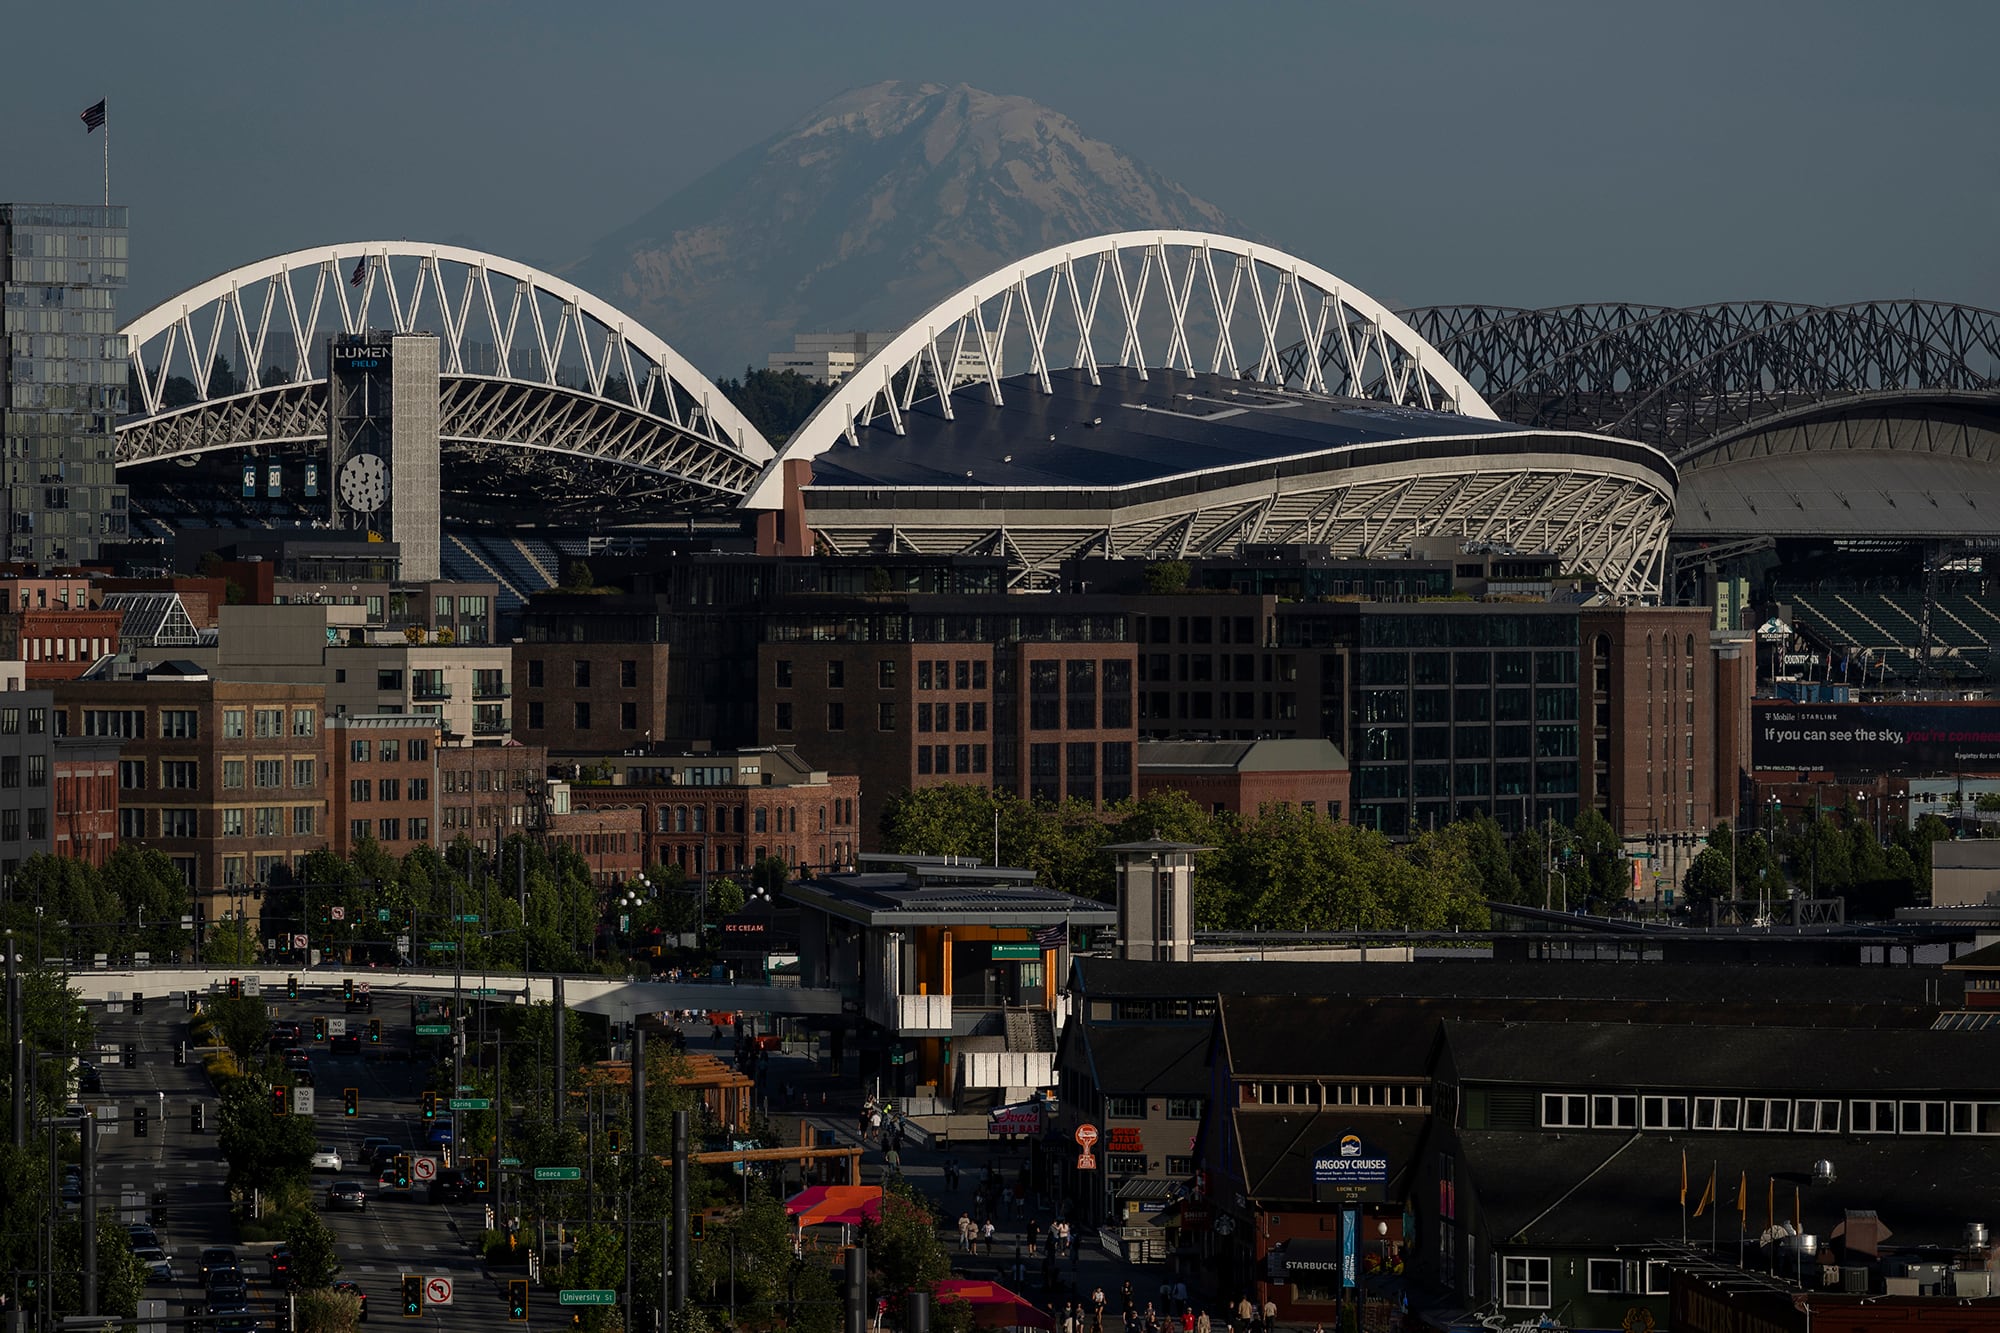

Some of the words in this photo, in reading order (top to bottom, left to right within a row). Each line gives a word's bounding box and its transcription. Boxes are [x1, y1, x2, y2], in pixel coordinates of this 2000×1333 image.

[335, 347, 392, 359] LUMEN
[351, 360, 378, 368] FIELD
[244, 471, 256, 487] 45
[269, 471, 281, 487] 80
[307, 471, 316, 486] 12
[1764, 728, 1775, 741] If
[1776, 730, 1800, 743] you
[1803, 730, 1828, 741] can
[1829, 731, 1853, 741] see
[1854, 728, 1877, 741] the
[1878, 729, 1904, 744] sky,
[1905, 728, 1946, 744] you're
[725, 924, 737, 932] ICE
[738, 924, 765, 932] CREAM
[452, 1101, 472, 1109] Spring
[992, 1124, 1015, 1133] FISH
[1019, 1124, 1040, 1133] BAR
[1111, 1135, 1140, 1143] STATE
[1109, 1143, 1143, 1151] BURGER
[1315, 1159, 1351, 1170] ARGOSY
[1351, 1159, 1387, 1170] CRUISES
[562, 1292, 601, 1303] University
[604, 1293, 613, 1301] St
[1687, 1288, 1735, 1333] MINERS
[1482, 1313, 1539, 1333] Seattle
